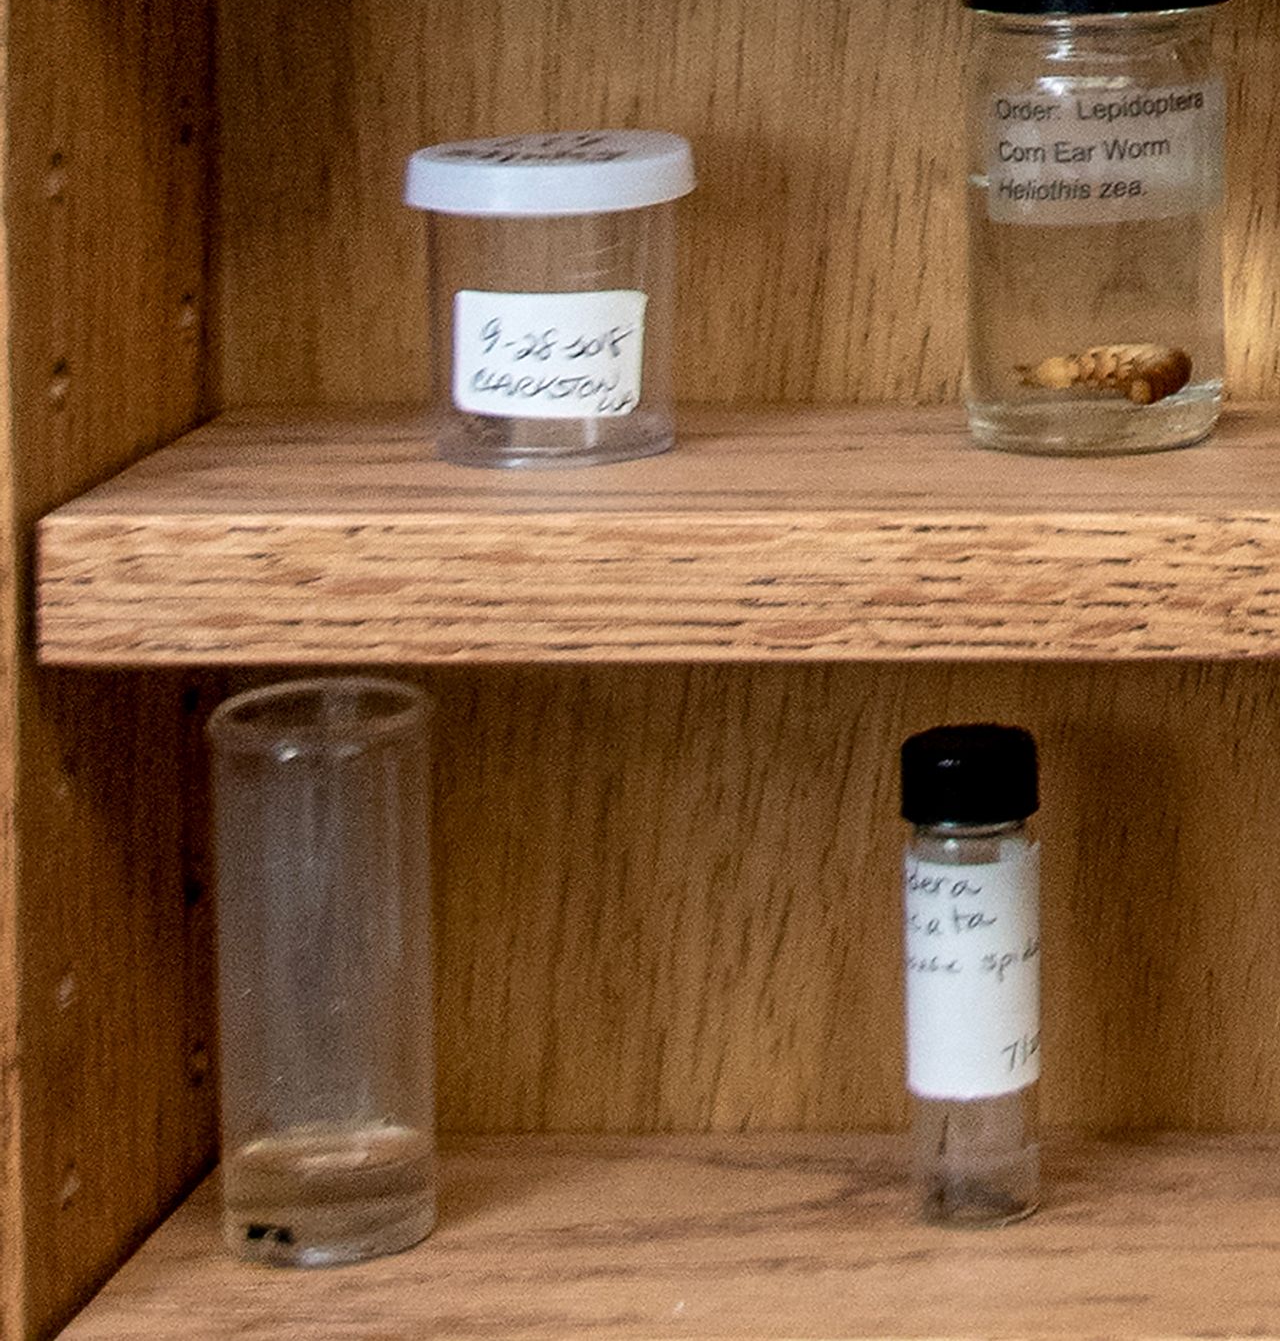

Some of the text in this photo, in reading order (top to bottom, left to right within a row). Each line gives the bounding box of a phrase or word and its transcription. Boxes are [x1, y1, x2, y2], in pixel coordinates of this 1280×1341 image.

[1076, 90, 1205, 122] Lepidoptera
[999, 137, 1171, 164] Corn Ear Worm
[999, 176, 1092, 202] Heliothis
